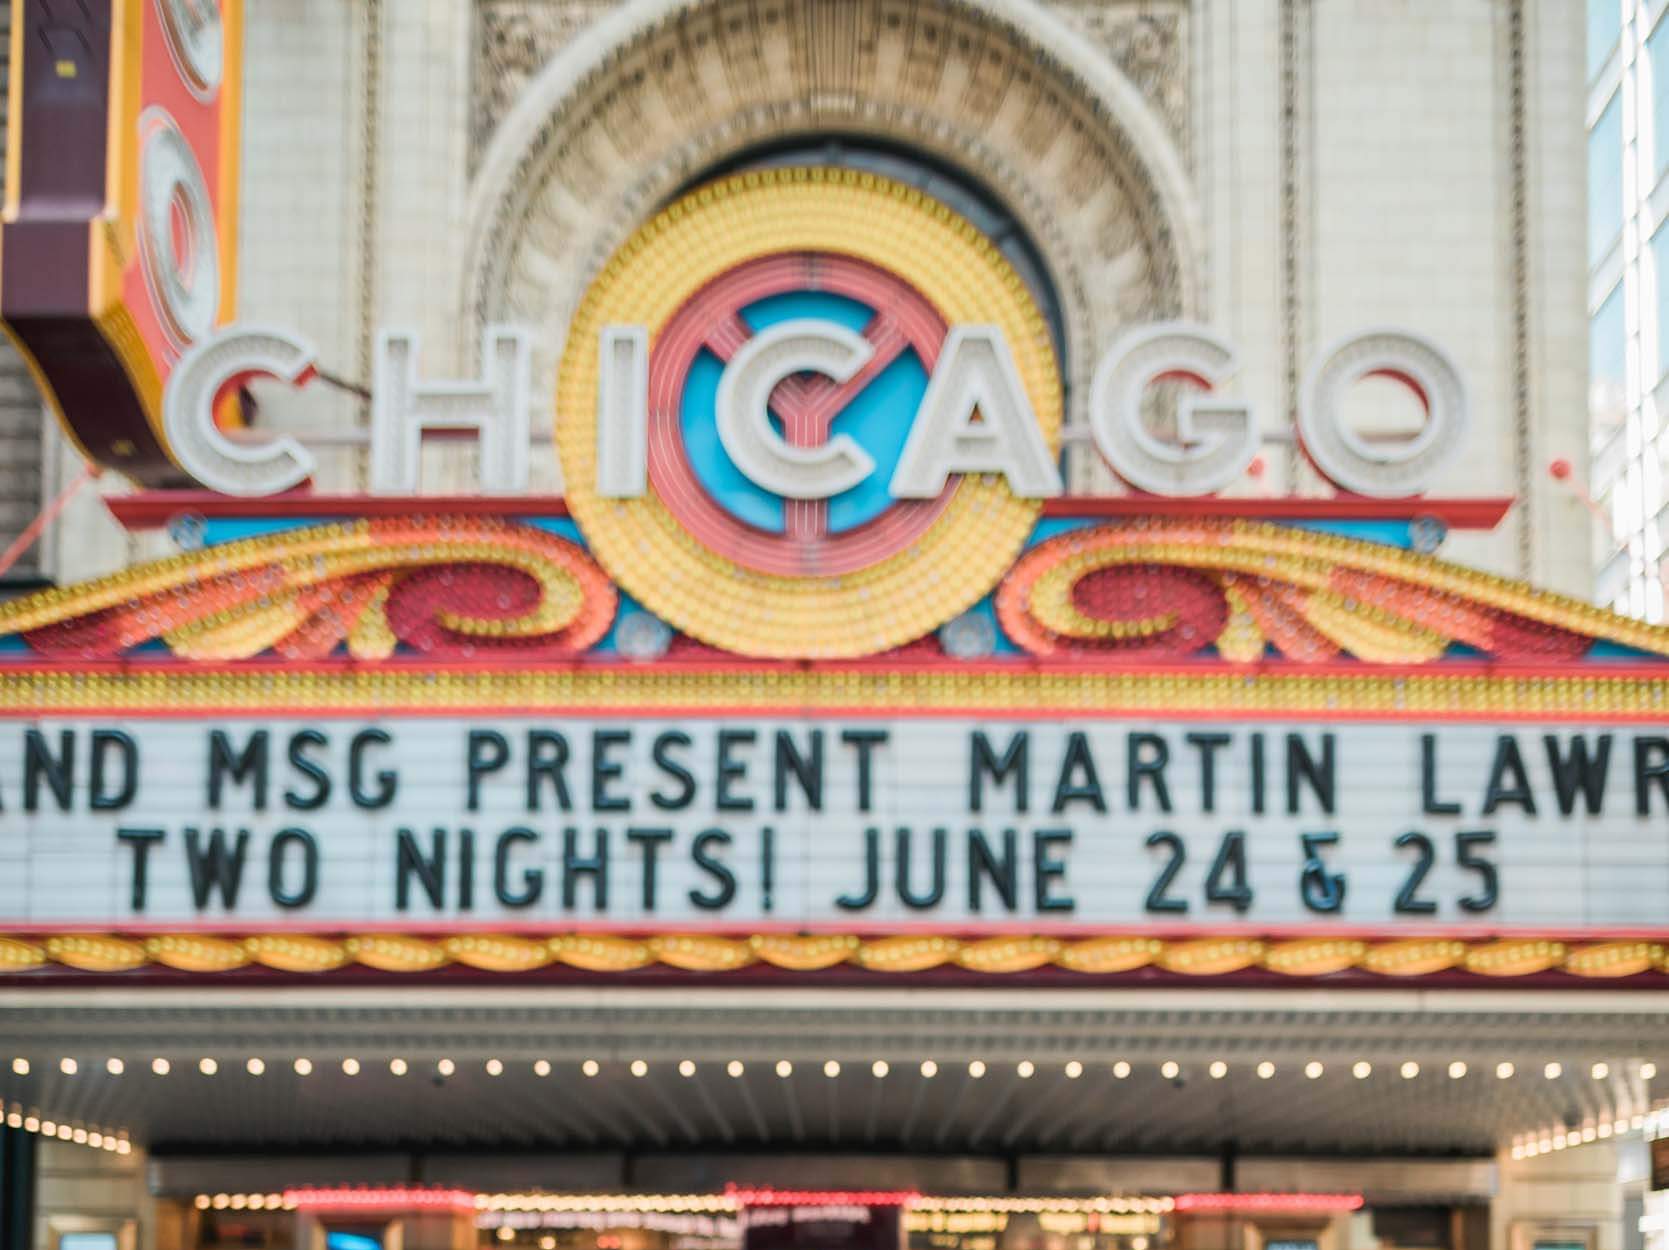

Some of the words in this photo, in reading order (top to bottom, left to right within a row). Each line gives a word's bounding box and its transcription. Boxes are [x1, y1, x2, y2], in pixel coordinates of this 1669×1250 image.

[163, 318, 1466, 498] CHICAGO
[0, 730, 138, 812] ND
[207, 730, 397, 812] MSG
[467, 730, 889, 812] PRESENT
[970, 732, 1335, 814] MARTIN
[1422, 734, 1669, 817] LAWR
[116, 828, 318, 912] TWO
[395, 828, 774, 912] NIGHTS!
[836, 828, 1075, 914] JUNE
[1145, 832, 1252, 915] 24
[1393, 832, 1499, 916] 25
